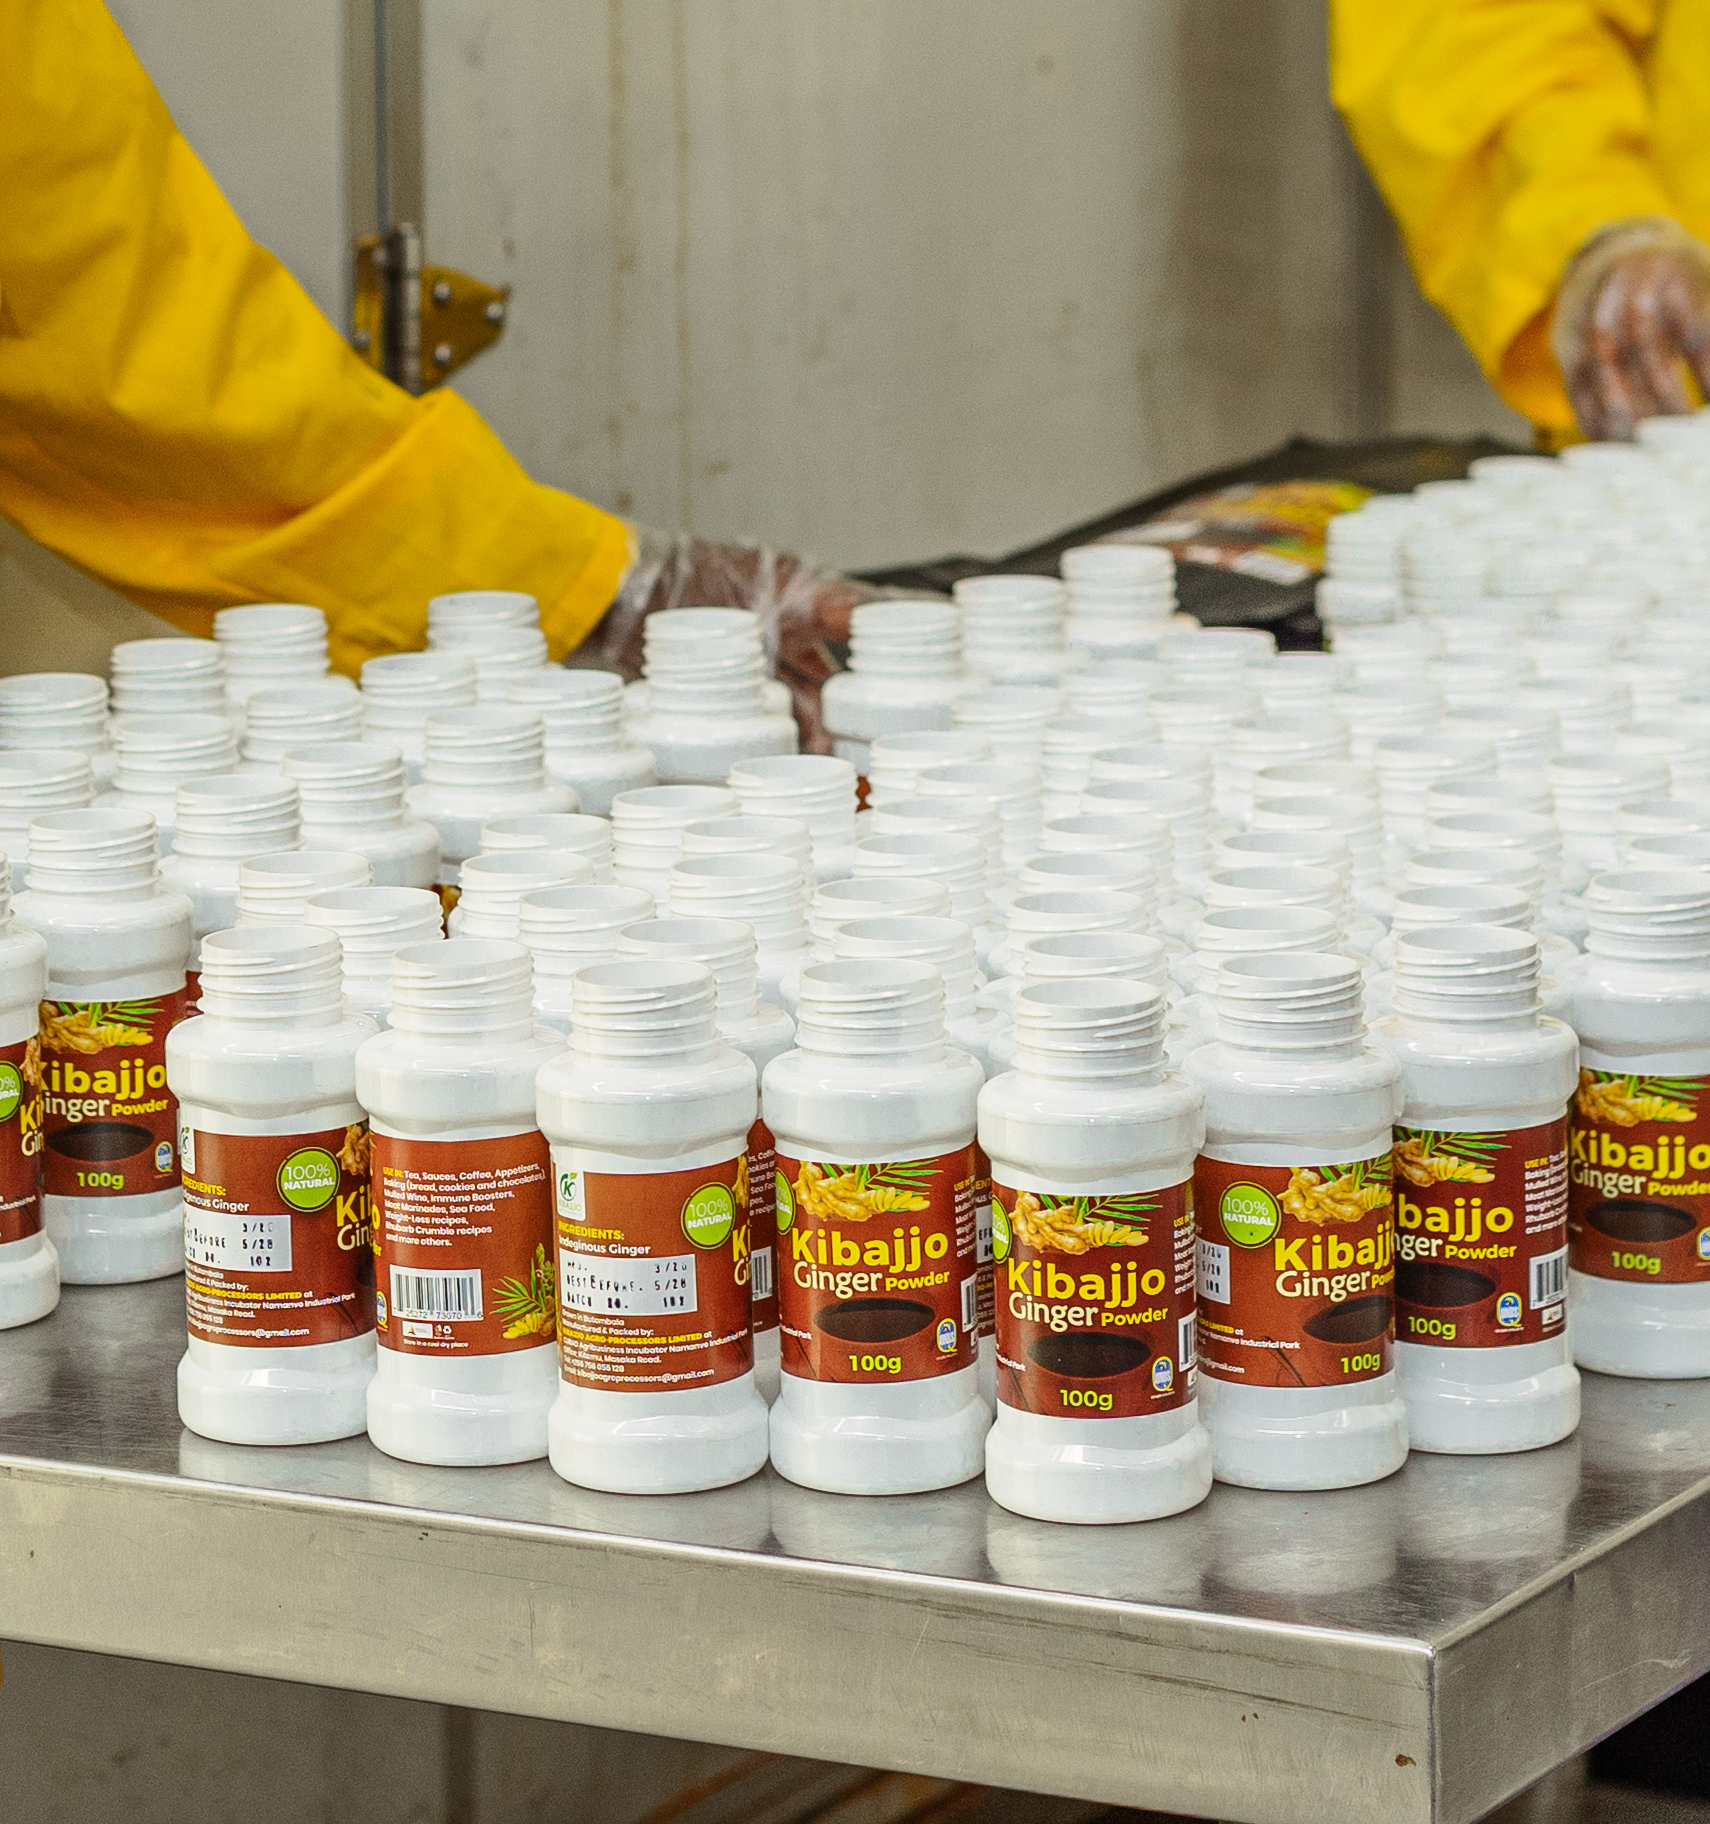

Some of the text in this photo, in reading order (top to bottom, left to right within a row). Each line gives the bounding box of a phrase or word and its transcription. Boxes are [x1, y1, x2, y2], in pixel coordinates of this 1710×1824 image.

[42, 1092, 110, 1123] inger
[111, 1098, 169, 1116] Powder
[77, 1171, 125, 1190] 100g
[285, 1163, 330, 1181] 100%
[422, 1172, 458, 1181] Sauces,
[459, 1170, 494, 1179] Coffee,
[1570, 1158, 1647, 1199] Ginger
[283, 1175, 336, 1190] NATURAL
[406, 1179, 438, 1192] (bread,
[439, 1183, 475, 1191] cookies
[477, 1180, 496, 1189] and
[212, 1198, 250, 1213] Ginger
[406, 1192, 430, 1203] Wine,
[431, 1194, 471, 1202] Immune
[1225, 1196, 1269, 1216] 100%
[449, 1206, 468, 1214] Sea
[689, 1199, 728, 1218] 100%
[1398, 1193, 1514, 1243] bajjo
[687, 1212, 732, 1229] NATURAL
[1223, 1212, 1275, 1227] NATURAL
[415, 1226, 454, 1235] Crumble
[456, 1225, 493, 1236] recipes
[558, 1221, 625, 1240] INGREDIENTS:
[399, 1236, 419, 1244] more
[420, 1236, 453, 1246] others.
[608, 1243, 651, 1256] Ginger
[792, 1226, 949, 1273] Kibajjo
[1274, 1220, 1395, 1271] Kibajj
[1444, 1244, 1517, 1260] Powder
[1611, 1251, 1661, 1275] 100g
[793, 1261, 950, 1299] Ginger Powder
[1008, 1257, 1166, 1308] Kibajjo
[1276, 1270, 1371, 1303] Ginger
[1008, 1291, 1168, 1332] Ginger Powder
[609, 1328, 639, 1336] Packed
[1408, 1316, 1457, 1340] 100g
[668, 1332, 702, 1344] LIMITED
[1280, 1341, 1301, 1349] Park
[848, 1355, 902, 1374] 100g
[1341, 1352, 1381, 1374] 100g
[1060, 1389, 1113, 1411] 100g
